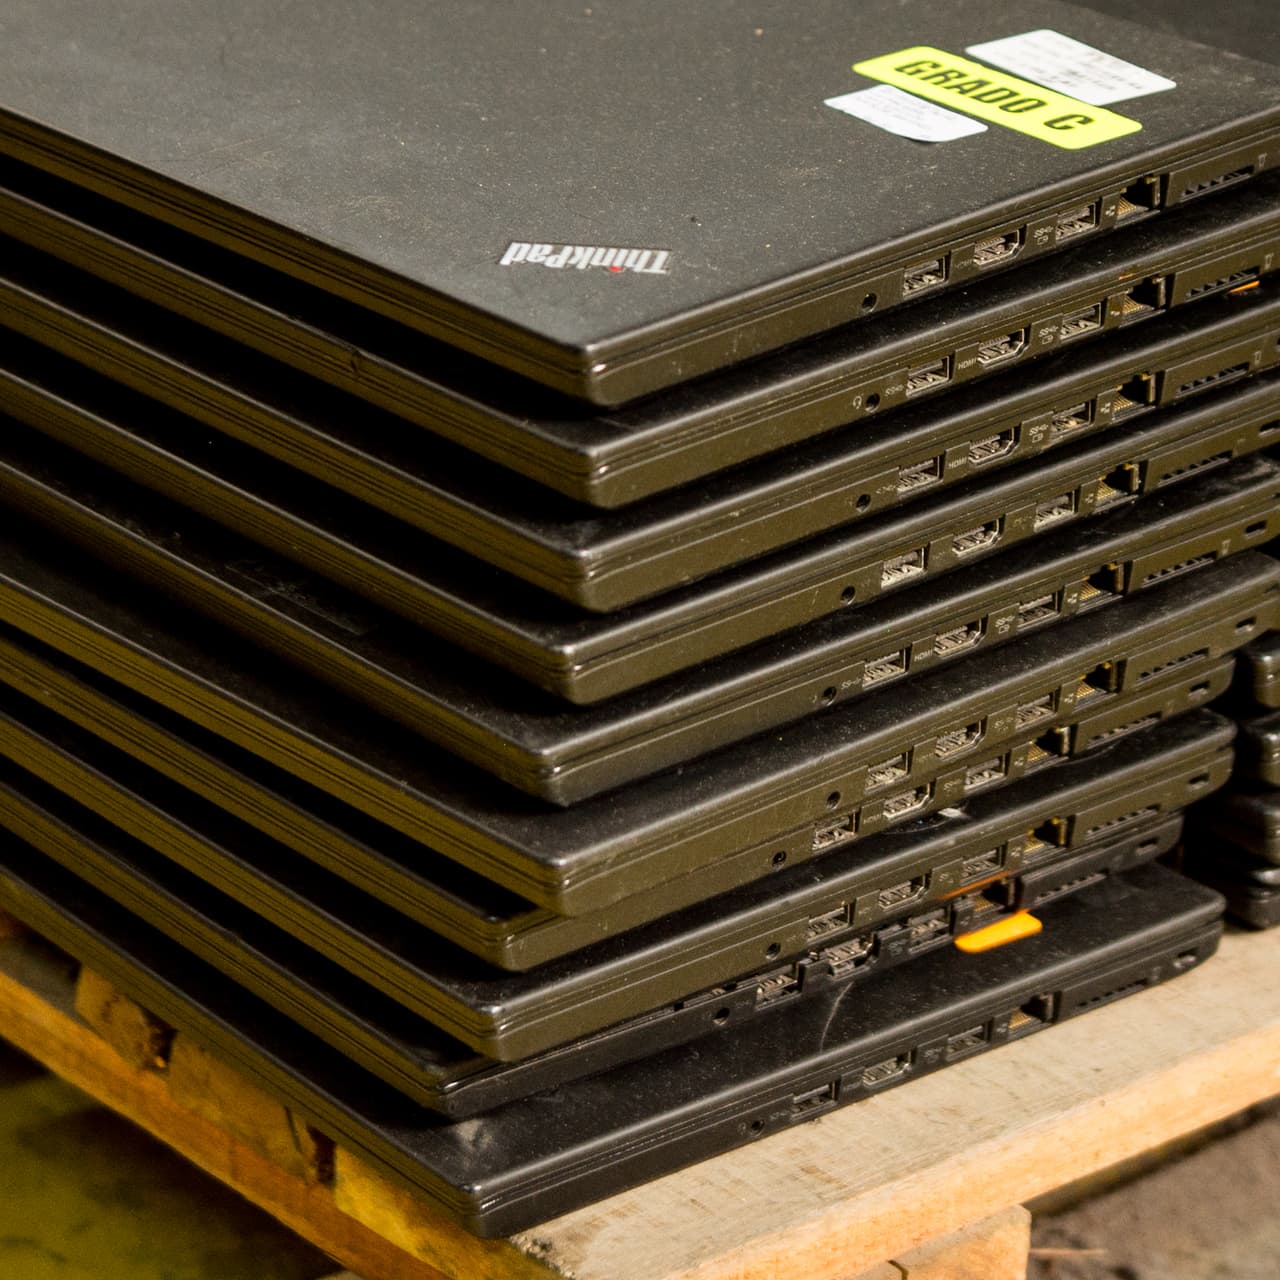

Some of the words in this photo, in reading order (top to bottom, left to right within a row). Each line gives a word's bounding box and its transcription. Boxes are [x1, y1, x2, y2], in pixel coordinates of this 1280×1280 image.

[894, 59, 1049, 114] GRADO
[1043, 113, 1095, 131] C
[499, 241, 672, 275] ThinkPad
[914, 649, 933, 662] HDMI
